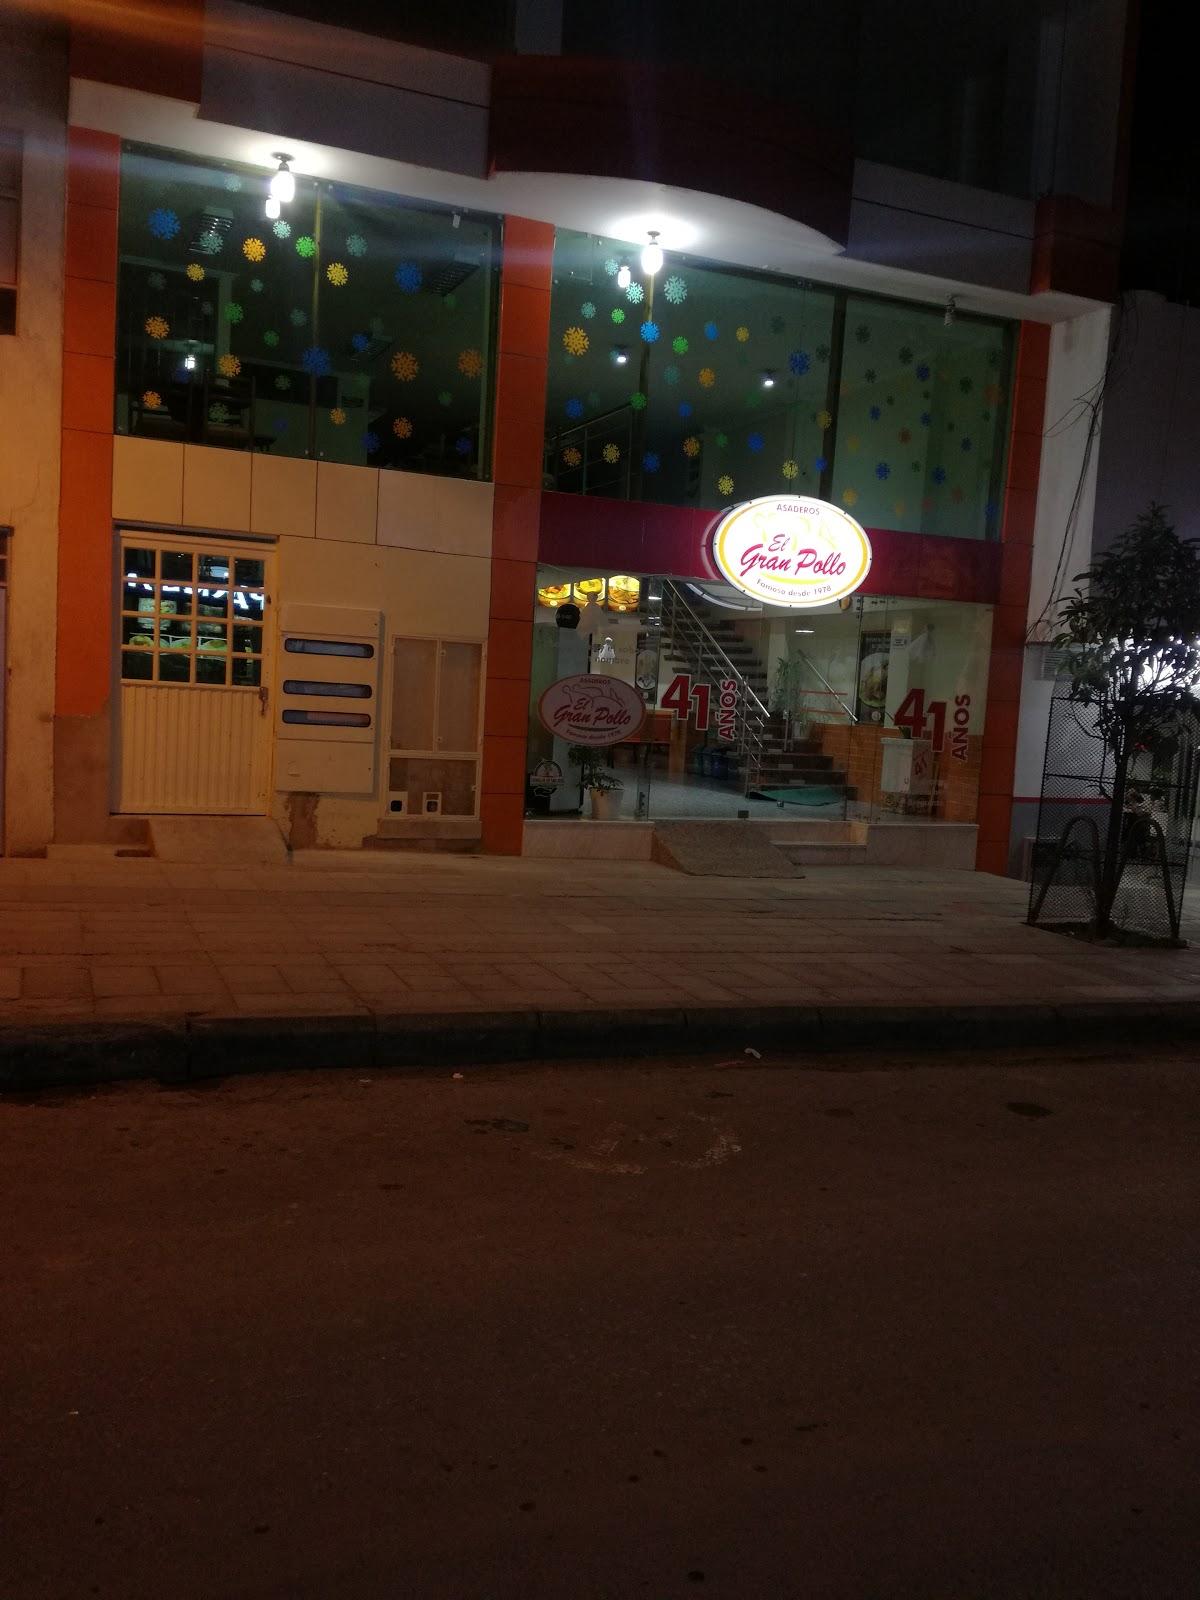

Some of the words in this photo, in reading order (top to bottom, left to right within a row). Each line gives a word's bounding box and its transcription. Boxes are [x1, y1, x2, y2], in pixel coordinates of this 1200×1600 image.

[776, 503, 820, 515] ASADEROS
[768, 533, 790, 552] El
[740, 543, 792, 577] Gran
[794, 548, 847, 576] Pollo
[756, 578, 786, 595] Famoso
[814, 585, 832, 595] 1978
[573, 697, 591, 710] El
[661, 674, 711, 731] 41
[553, 704, 591, 728] Gran
[592, 707, 632, 726] Pollo
[894, 688, 947, 752] 41
